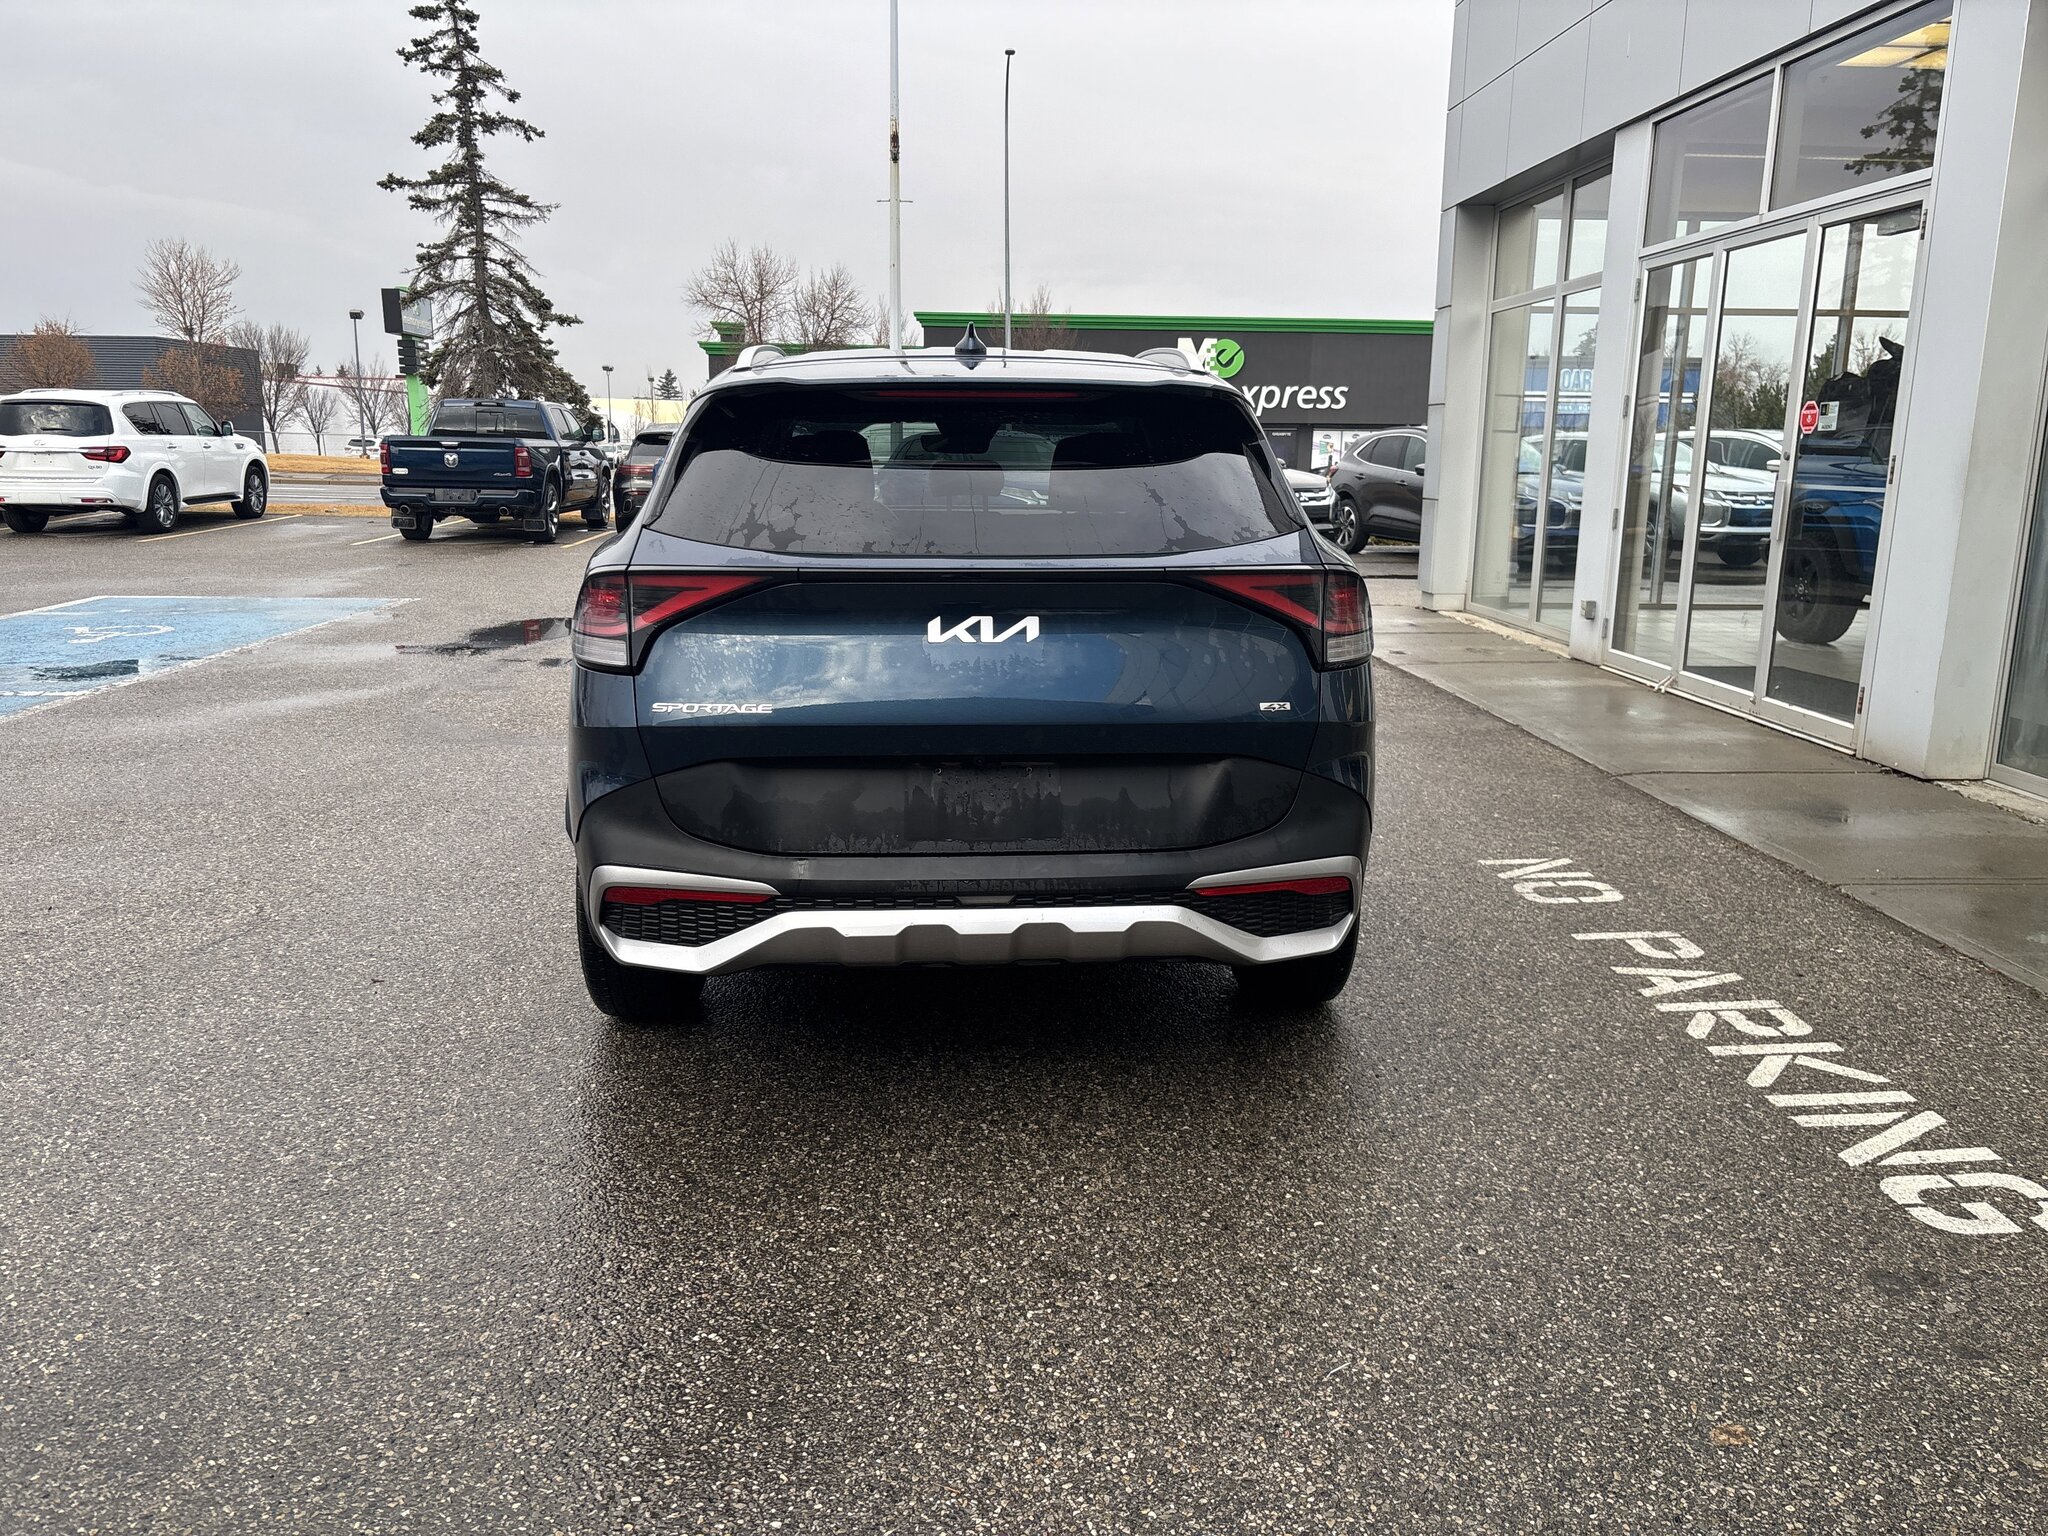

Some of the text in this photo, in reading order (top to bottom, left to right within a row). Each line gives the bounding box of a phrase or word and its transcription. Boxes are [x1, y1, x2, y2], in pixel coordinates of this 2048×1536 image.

[1241, 385, 1349, 417] xpress
[927, 615, 1040, 643] KIA
[651, 702, 773, 714] SPORTAGE
[1478, 857, 2048, 1234] NO PARKING
